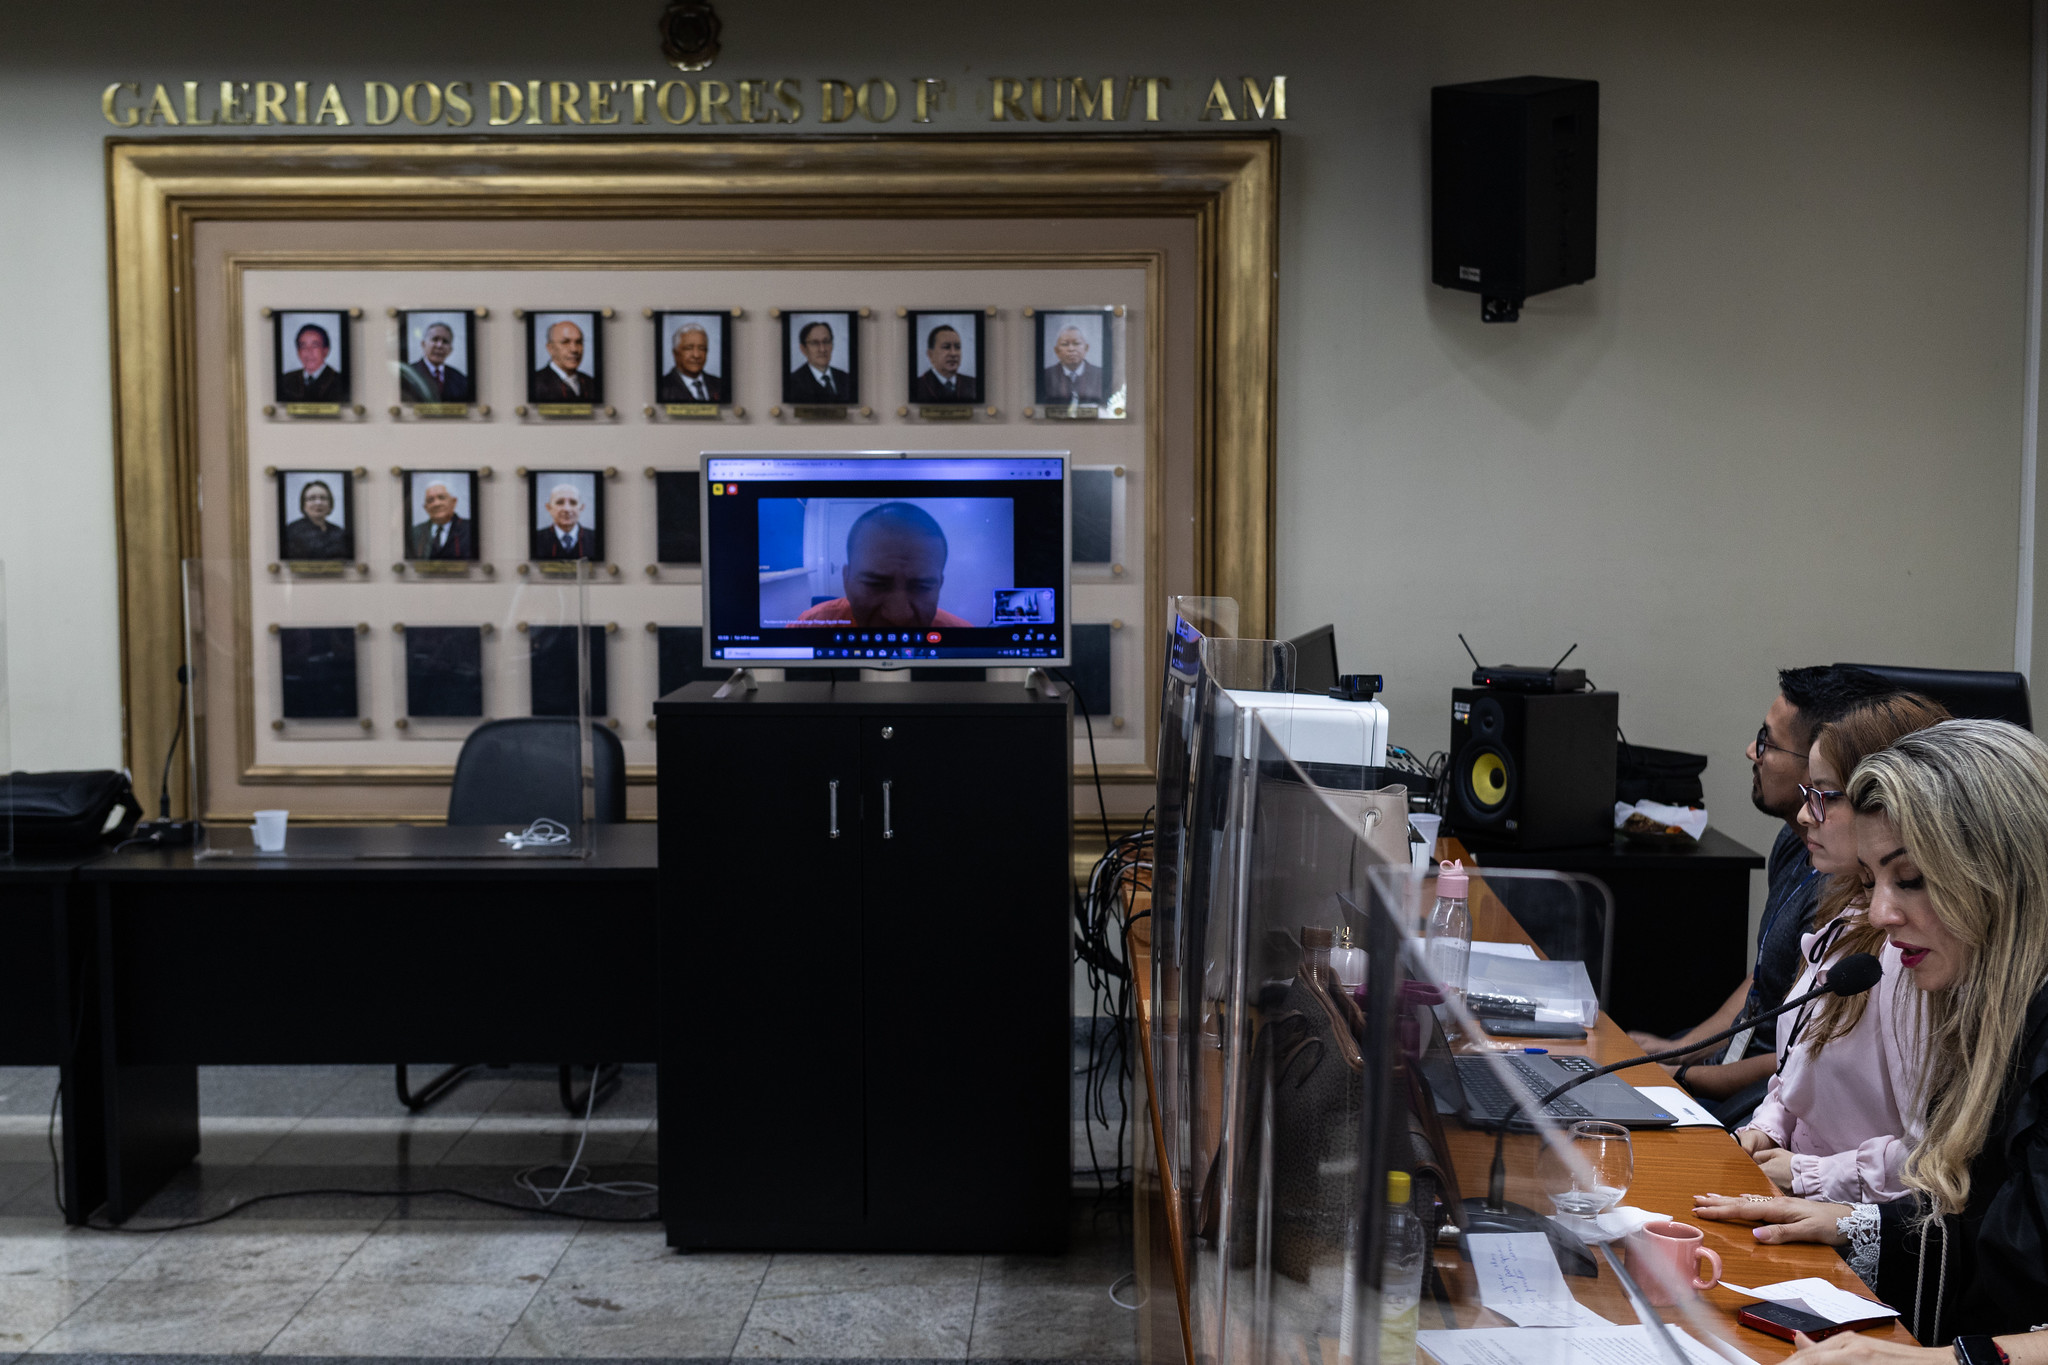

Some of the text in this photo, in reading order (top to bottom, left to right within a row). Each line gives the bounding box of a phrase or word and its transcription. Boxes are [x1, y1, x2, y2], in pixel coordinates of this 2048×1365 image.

[101, 80, 353, 127] GALERIA
[364, 80, 474, 126] DOS
[487, 79, 802, 126] DIRETORES
[819, 79, 898, 124] DO
